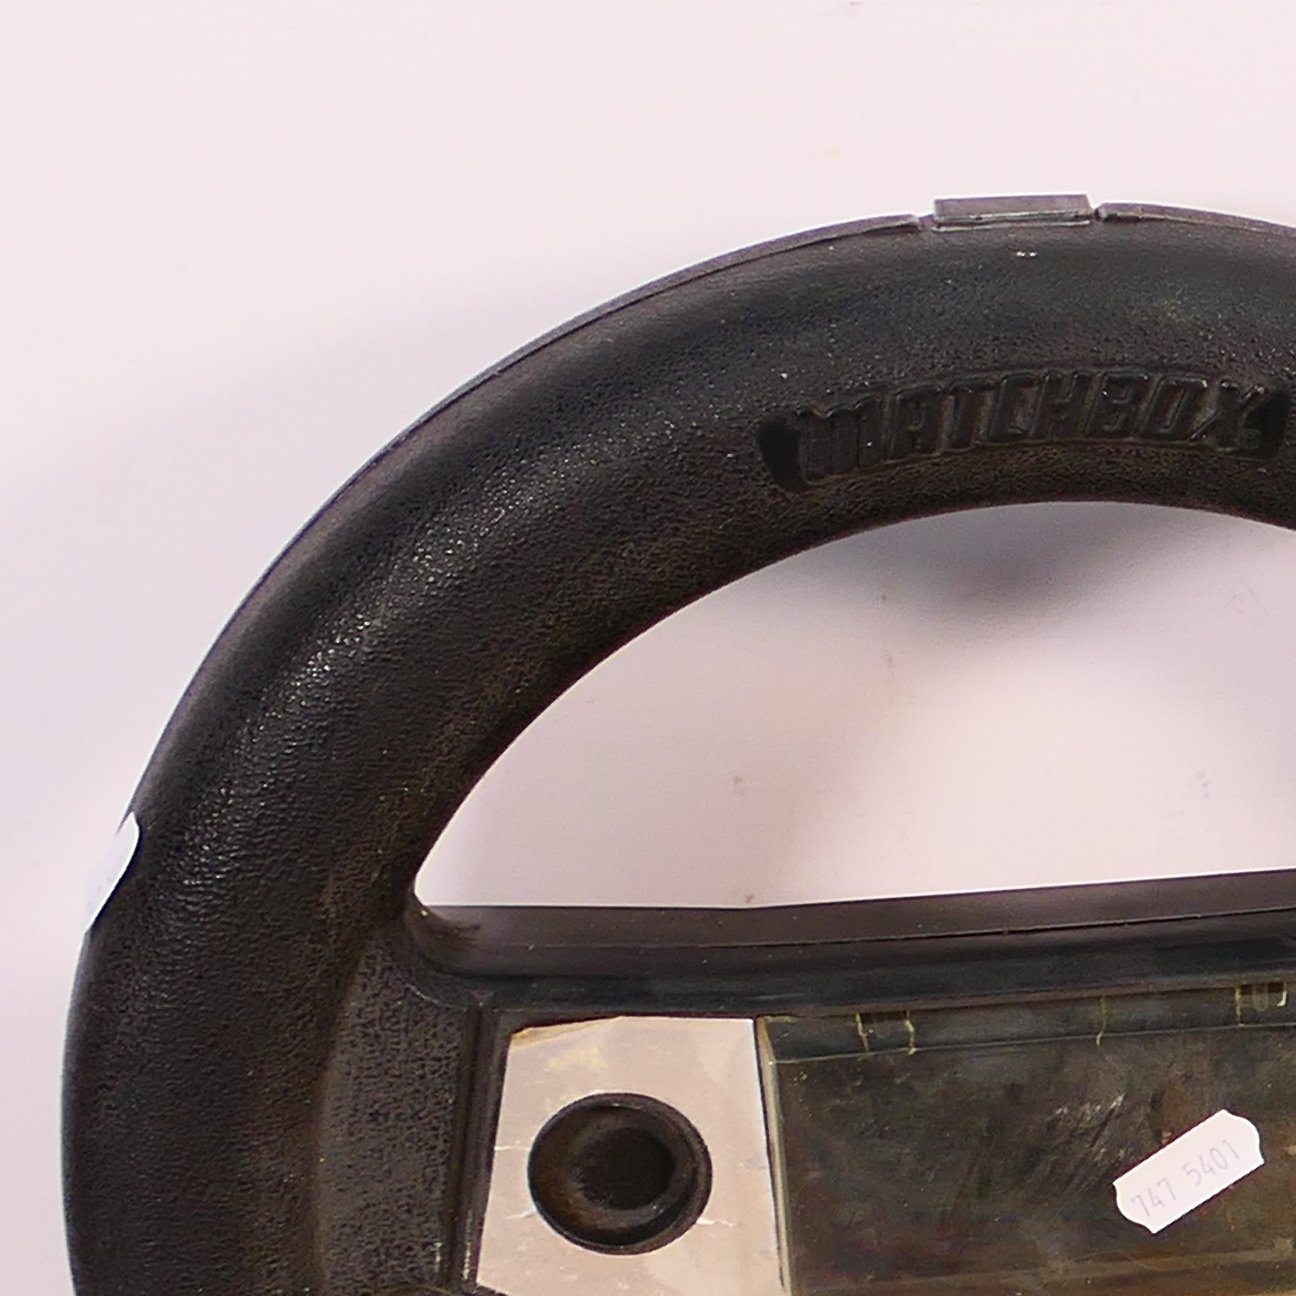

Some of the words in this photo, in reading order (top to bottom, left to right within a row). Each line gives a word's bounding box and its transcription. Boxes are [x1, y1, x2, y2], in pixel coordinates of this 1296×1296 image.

[797, 370, 1266, 484] MATCHBOX
[1131, 1176, 1180, 1218] 747
[1183, 1138, 1241, 1188] 5401
